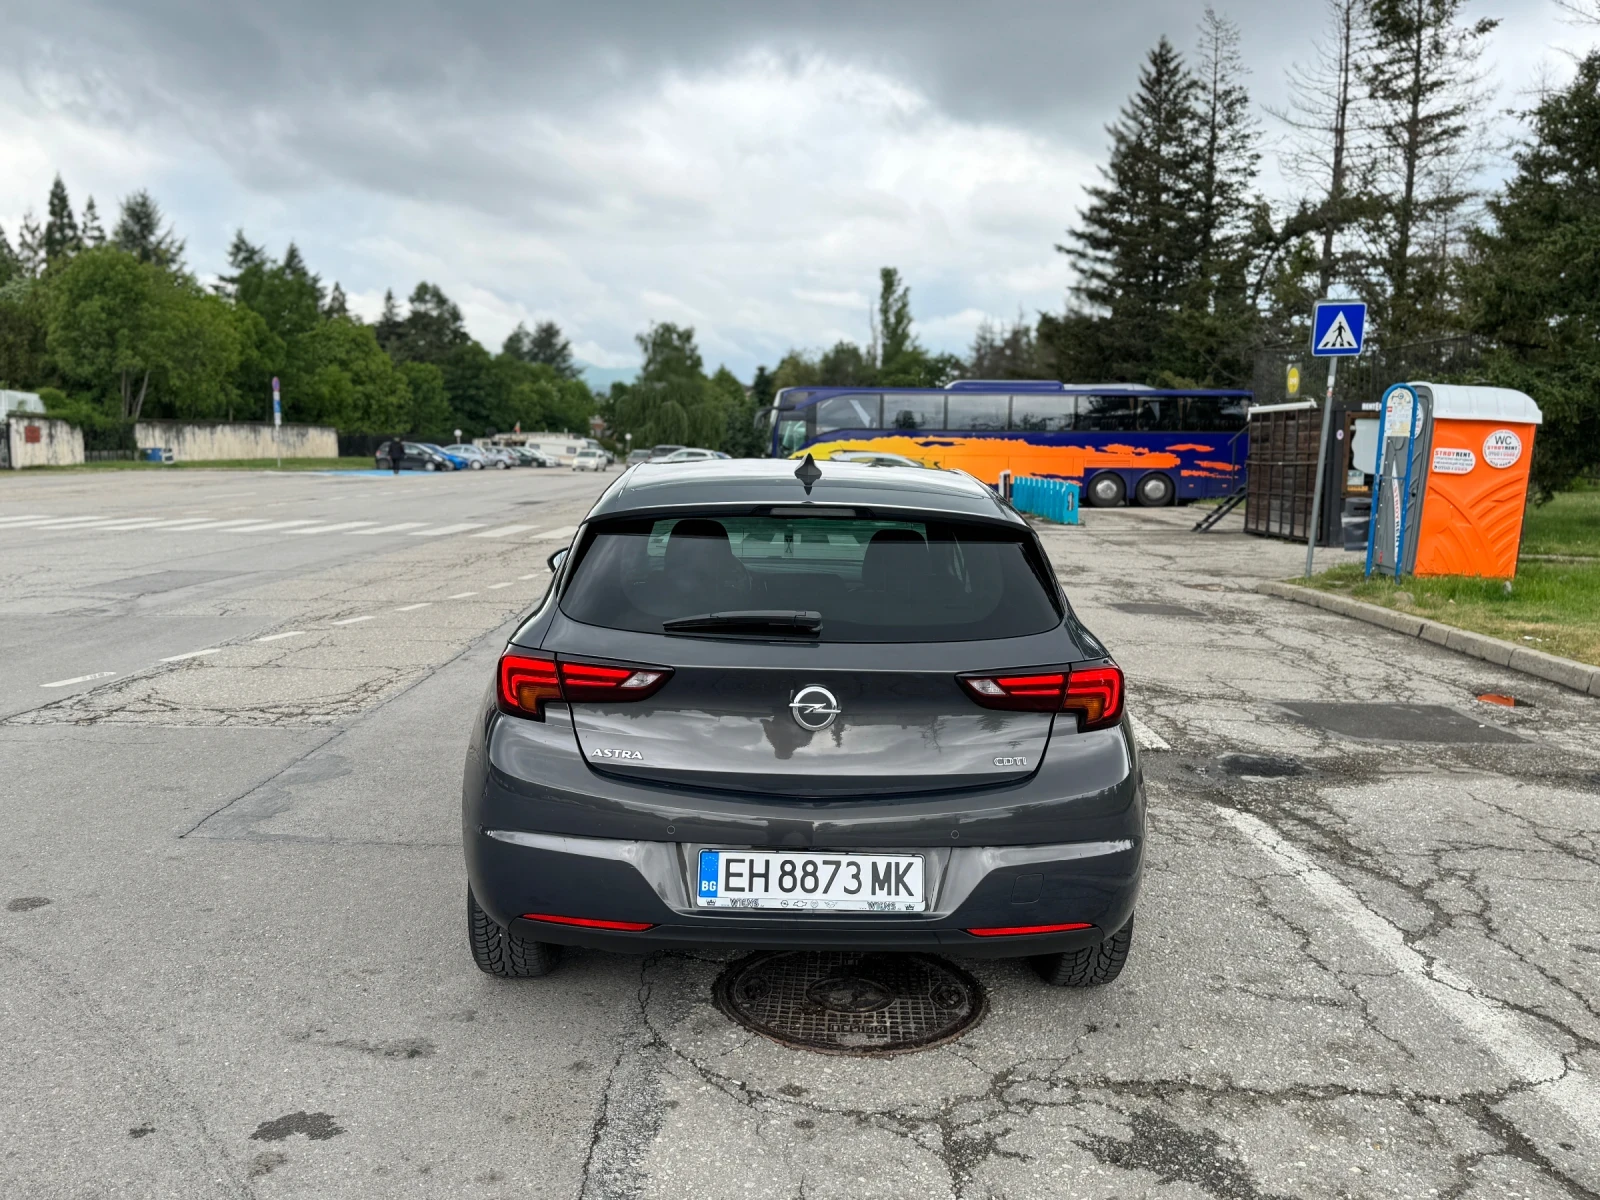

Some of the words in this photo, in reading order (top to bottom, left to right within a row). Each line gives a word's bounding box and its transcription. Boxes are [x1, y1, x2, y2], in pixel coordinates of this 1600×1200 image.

[1494, 435, 1512, 445] WC
[1435, 450, 1471, 458] STROYRENT
[591, 748, 643, 760] ASTRA
[993, 756, 1027, 766] CDTI
[724, 858, 770, 893] EH
[778, 859, 862, 895] 8873
[871, 861, 915, 897] MK
[701, 880, 717, 892] BG
